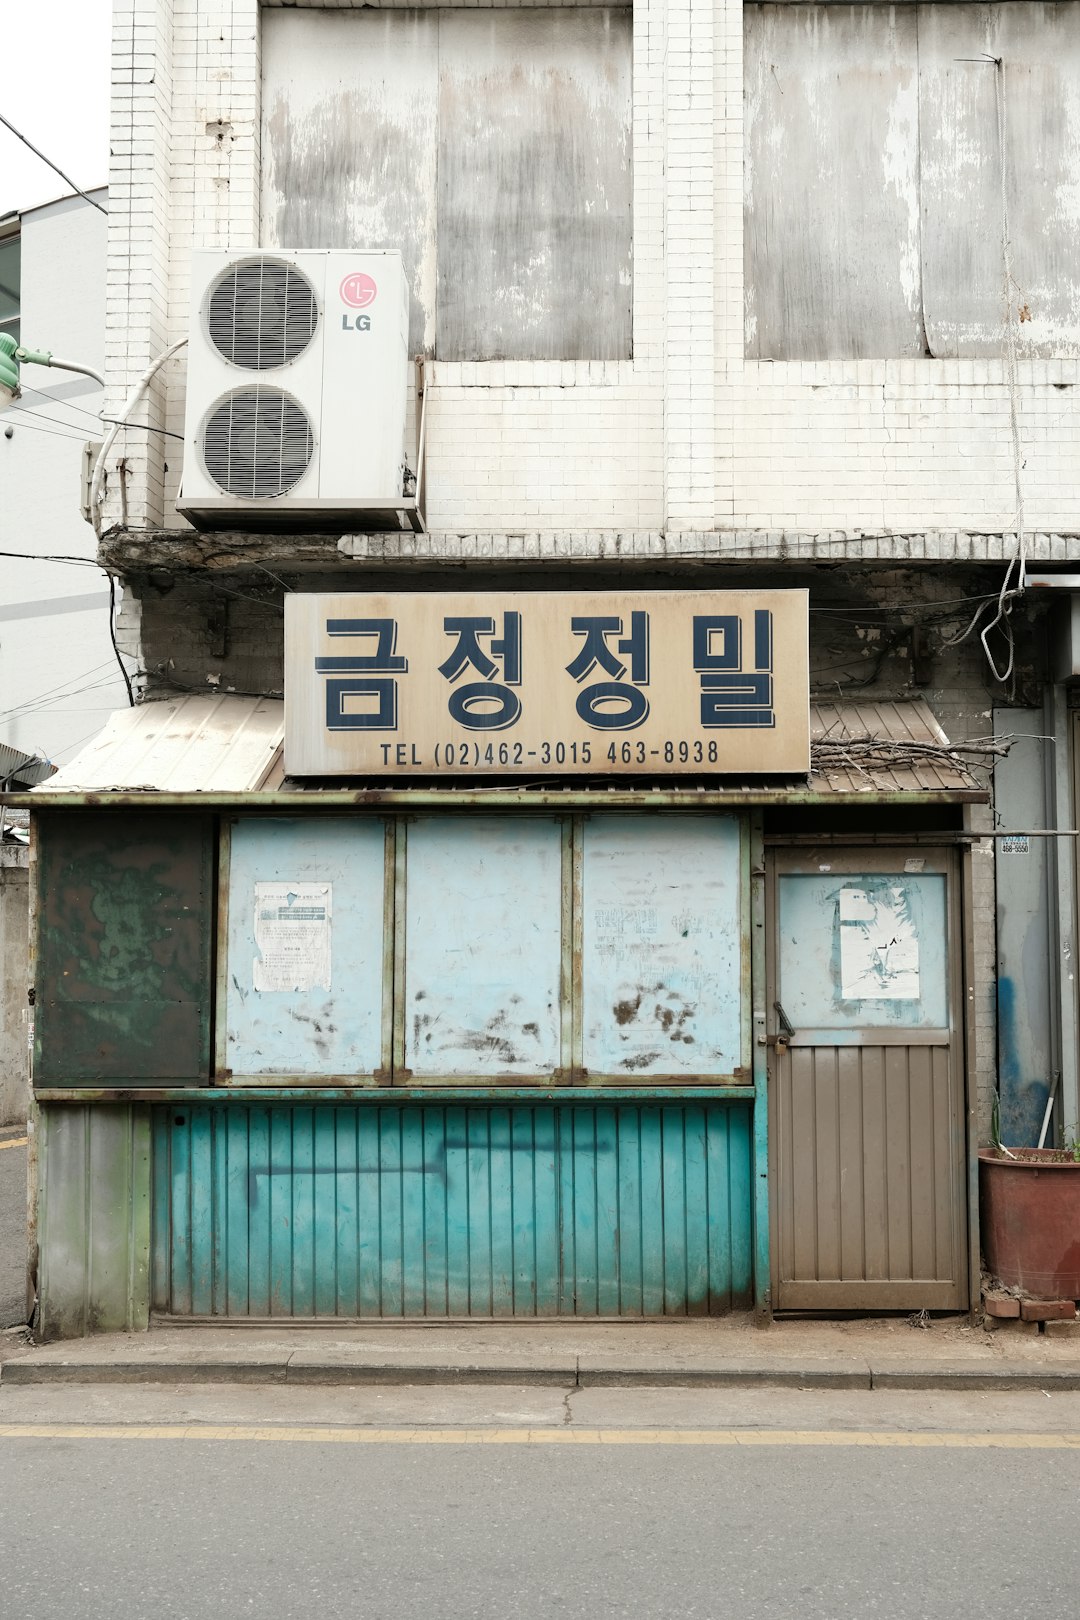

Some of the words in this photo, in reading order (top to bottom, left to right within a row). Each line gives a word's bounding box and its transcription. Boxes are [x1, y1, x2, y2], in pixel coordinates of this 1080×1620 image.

[342, 314, 371, 332] LG
[315, 610, 775, 732] 금정정밀
[380, 743, 422, 766] TEL
[434, 741, 592, 767] (02)462-3015
[607, 740, 719, 764] 463-8938
